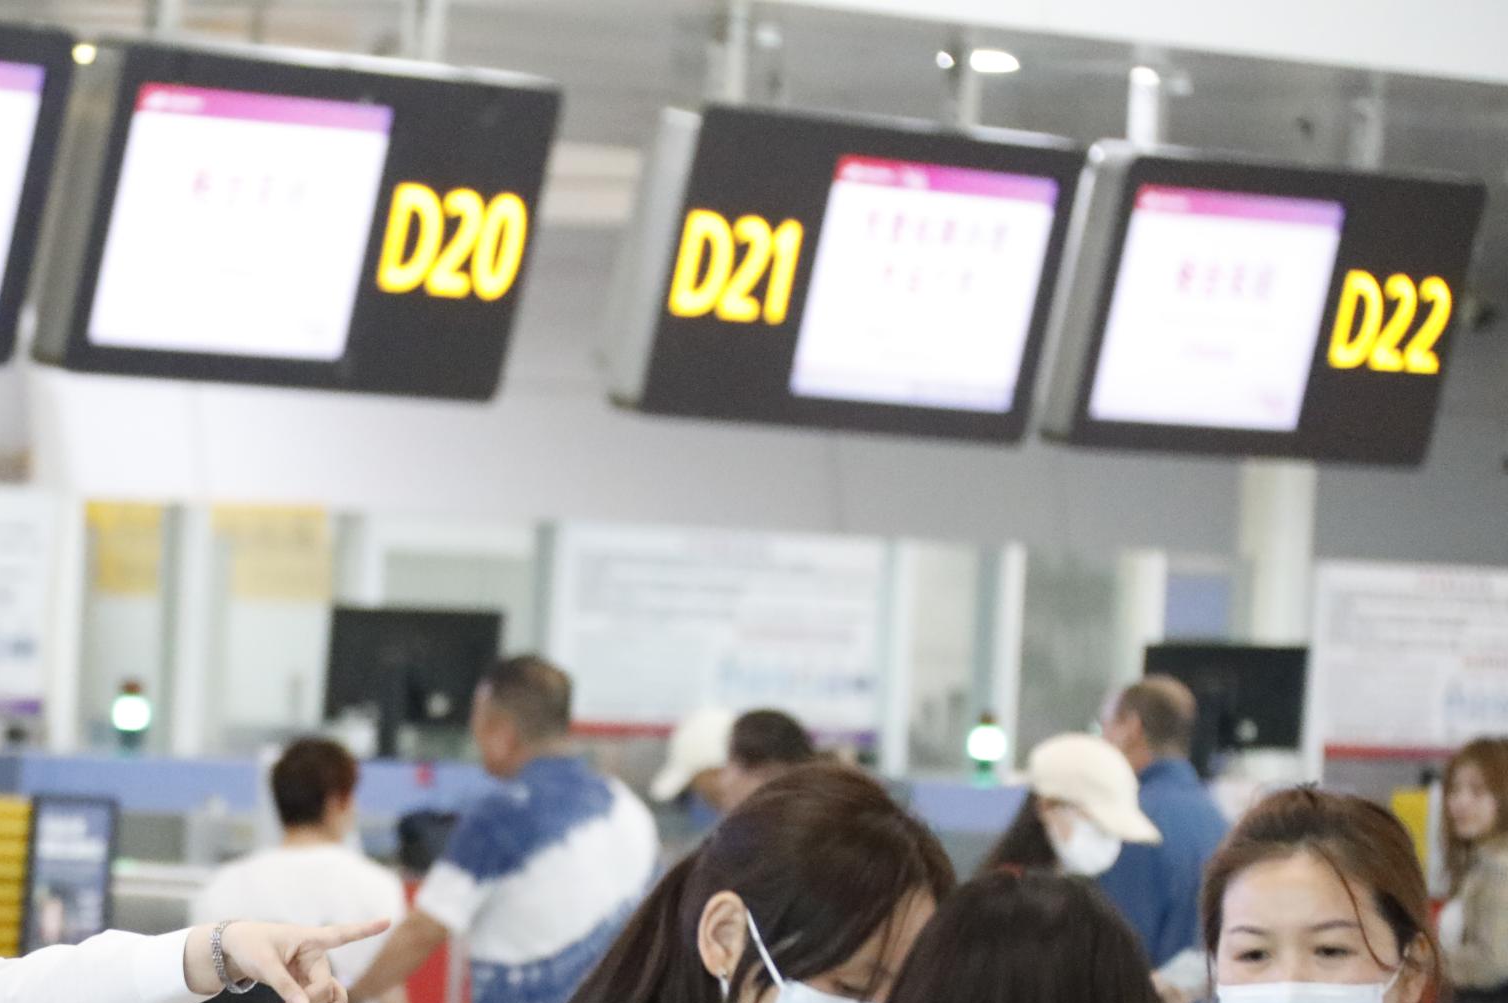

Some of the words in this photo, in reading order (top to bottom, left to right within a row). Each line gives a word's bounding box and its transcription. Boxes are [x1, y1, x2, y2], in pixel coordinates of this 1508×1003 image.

[377, 182, 527, 301] D20
[668, 209, 803, 324] D21
[1328, 270, 1452, 374] D22
